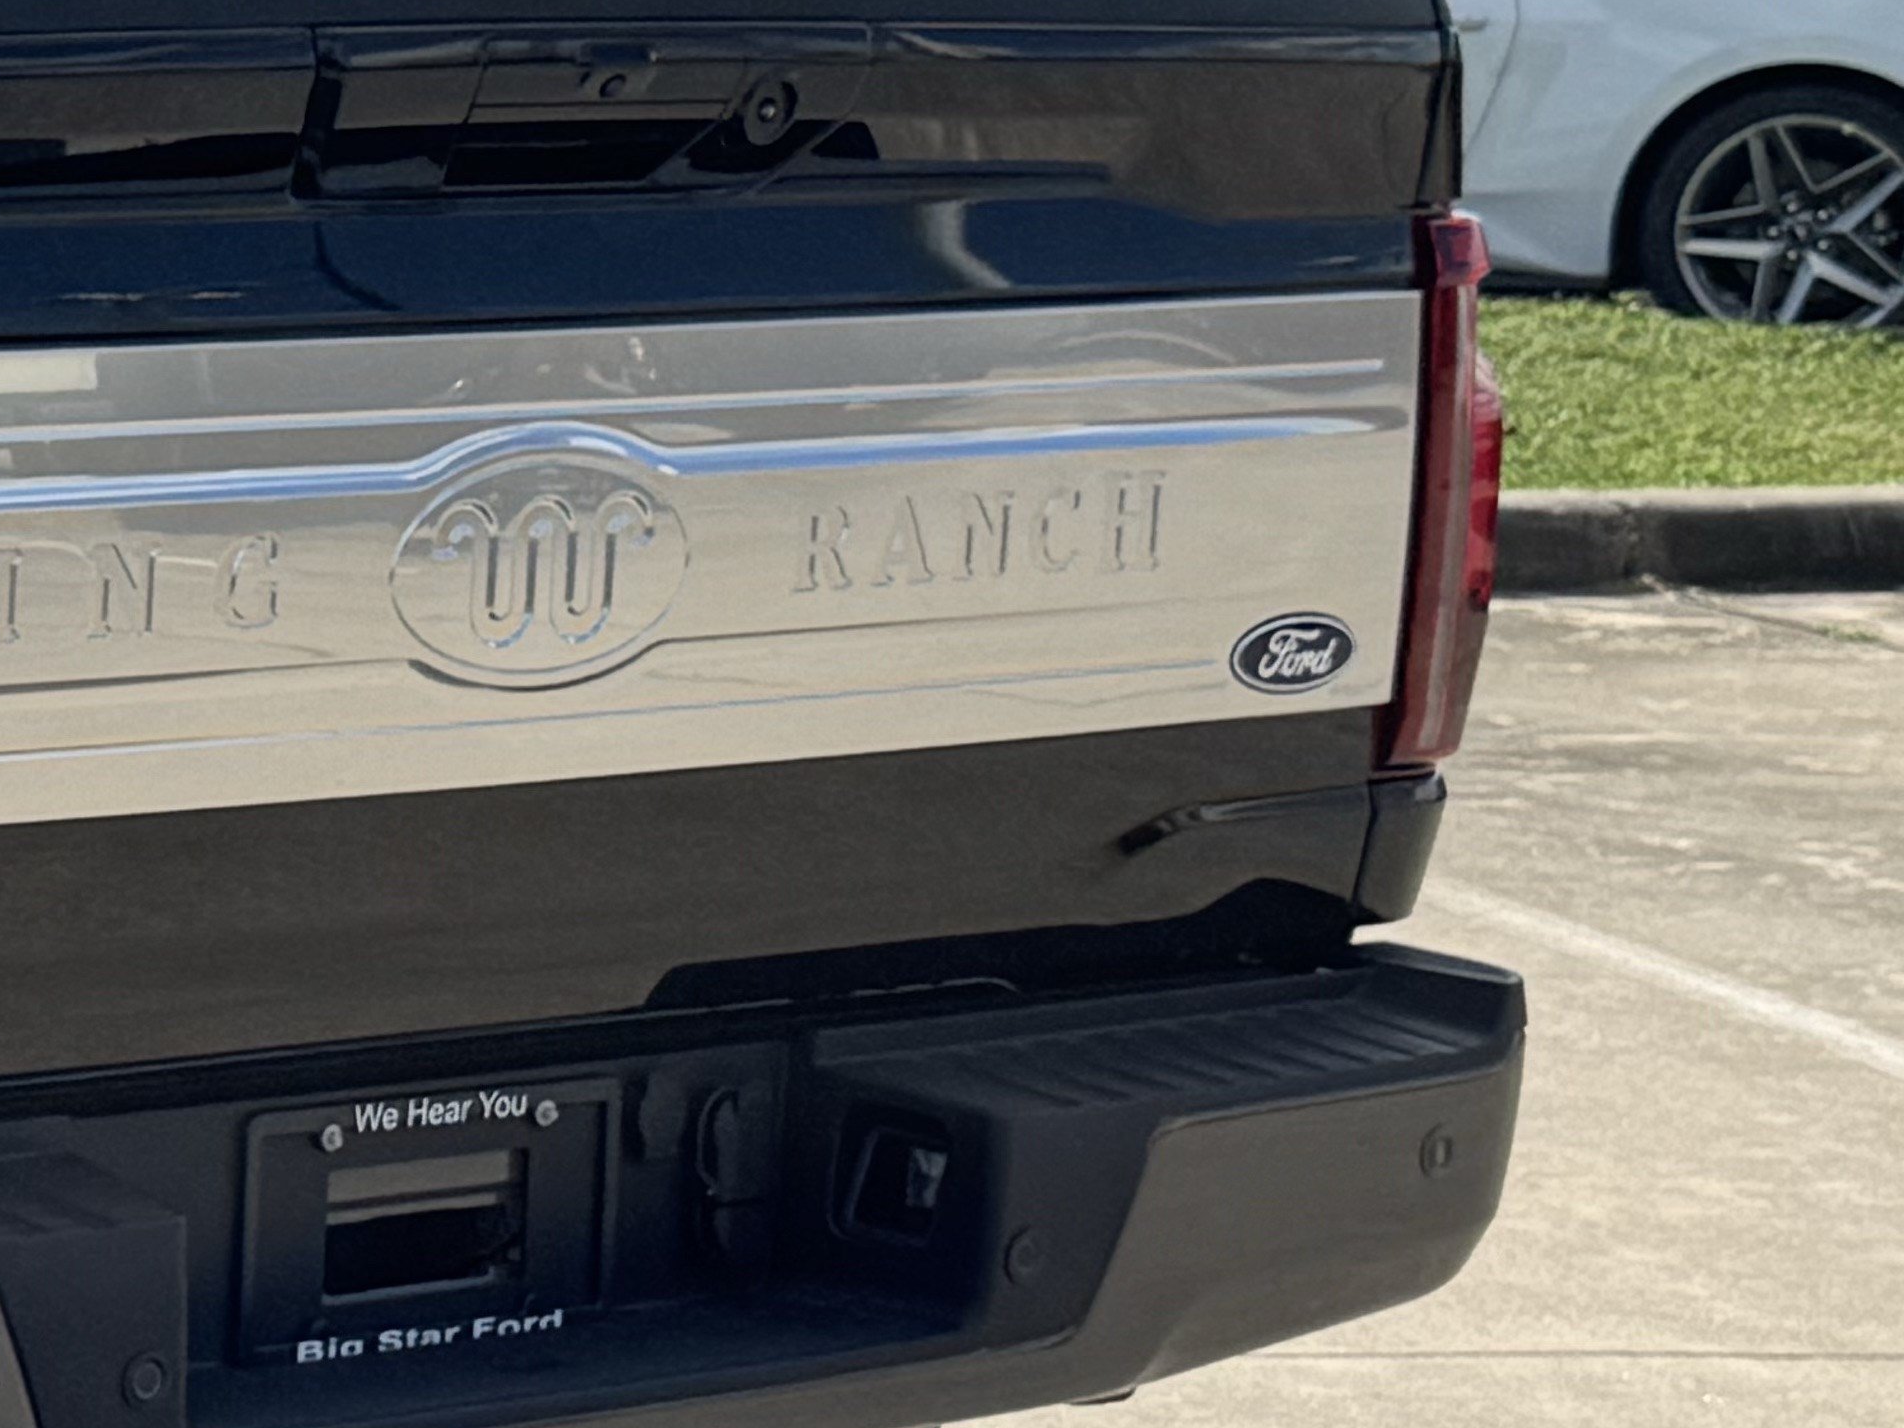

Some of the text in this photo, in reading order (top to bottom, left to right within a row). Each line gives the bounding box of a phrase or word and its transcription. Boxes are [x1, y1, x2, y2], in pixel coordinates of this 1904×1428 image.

[790, 469, 1168, 594] RANCH
[1258, 628, 1339, 679] Ford
[354, 1088, 530, 1134] We Hear You
[378, 1323, 462, 1355] Star
[473, 1308, 564, 1341] Ford
